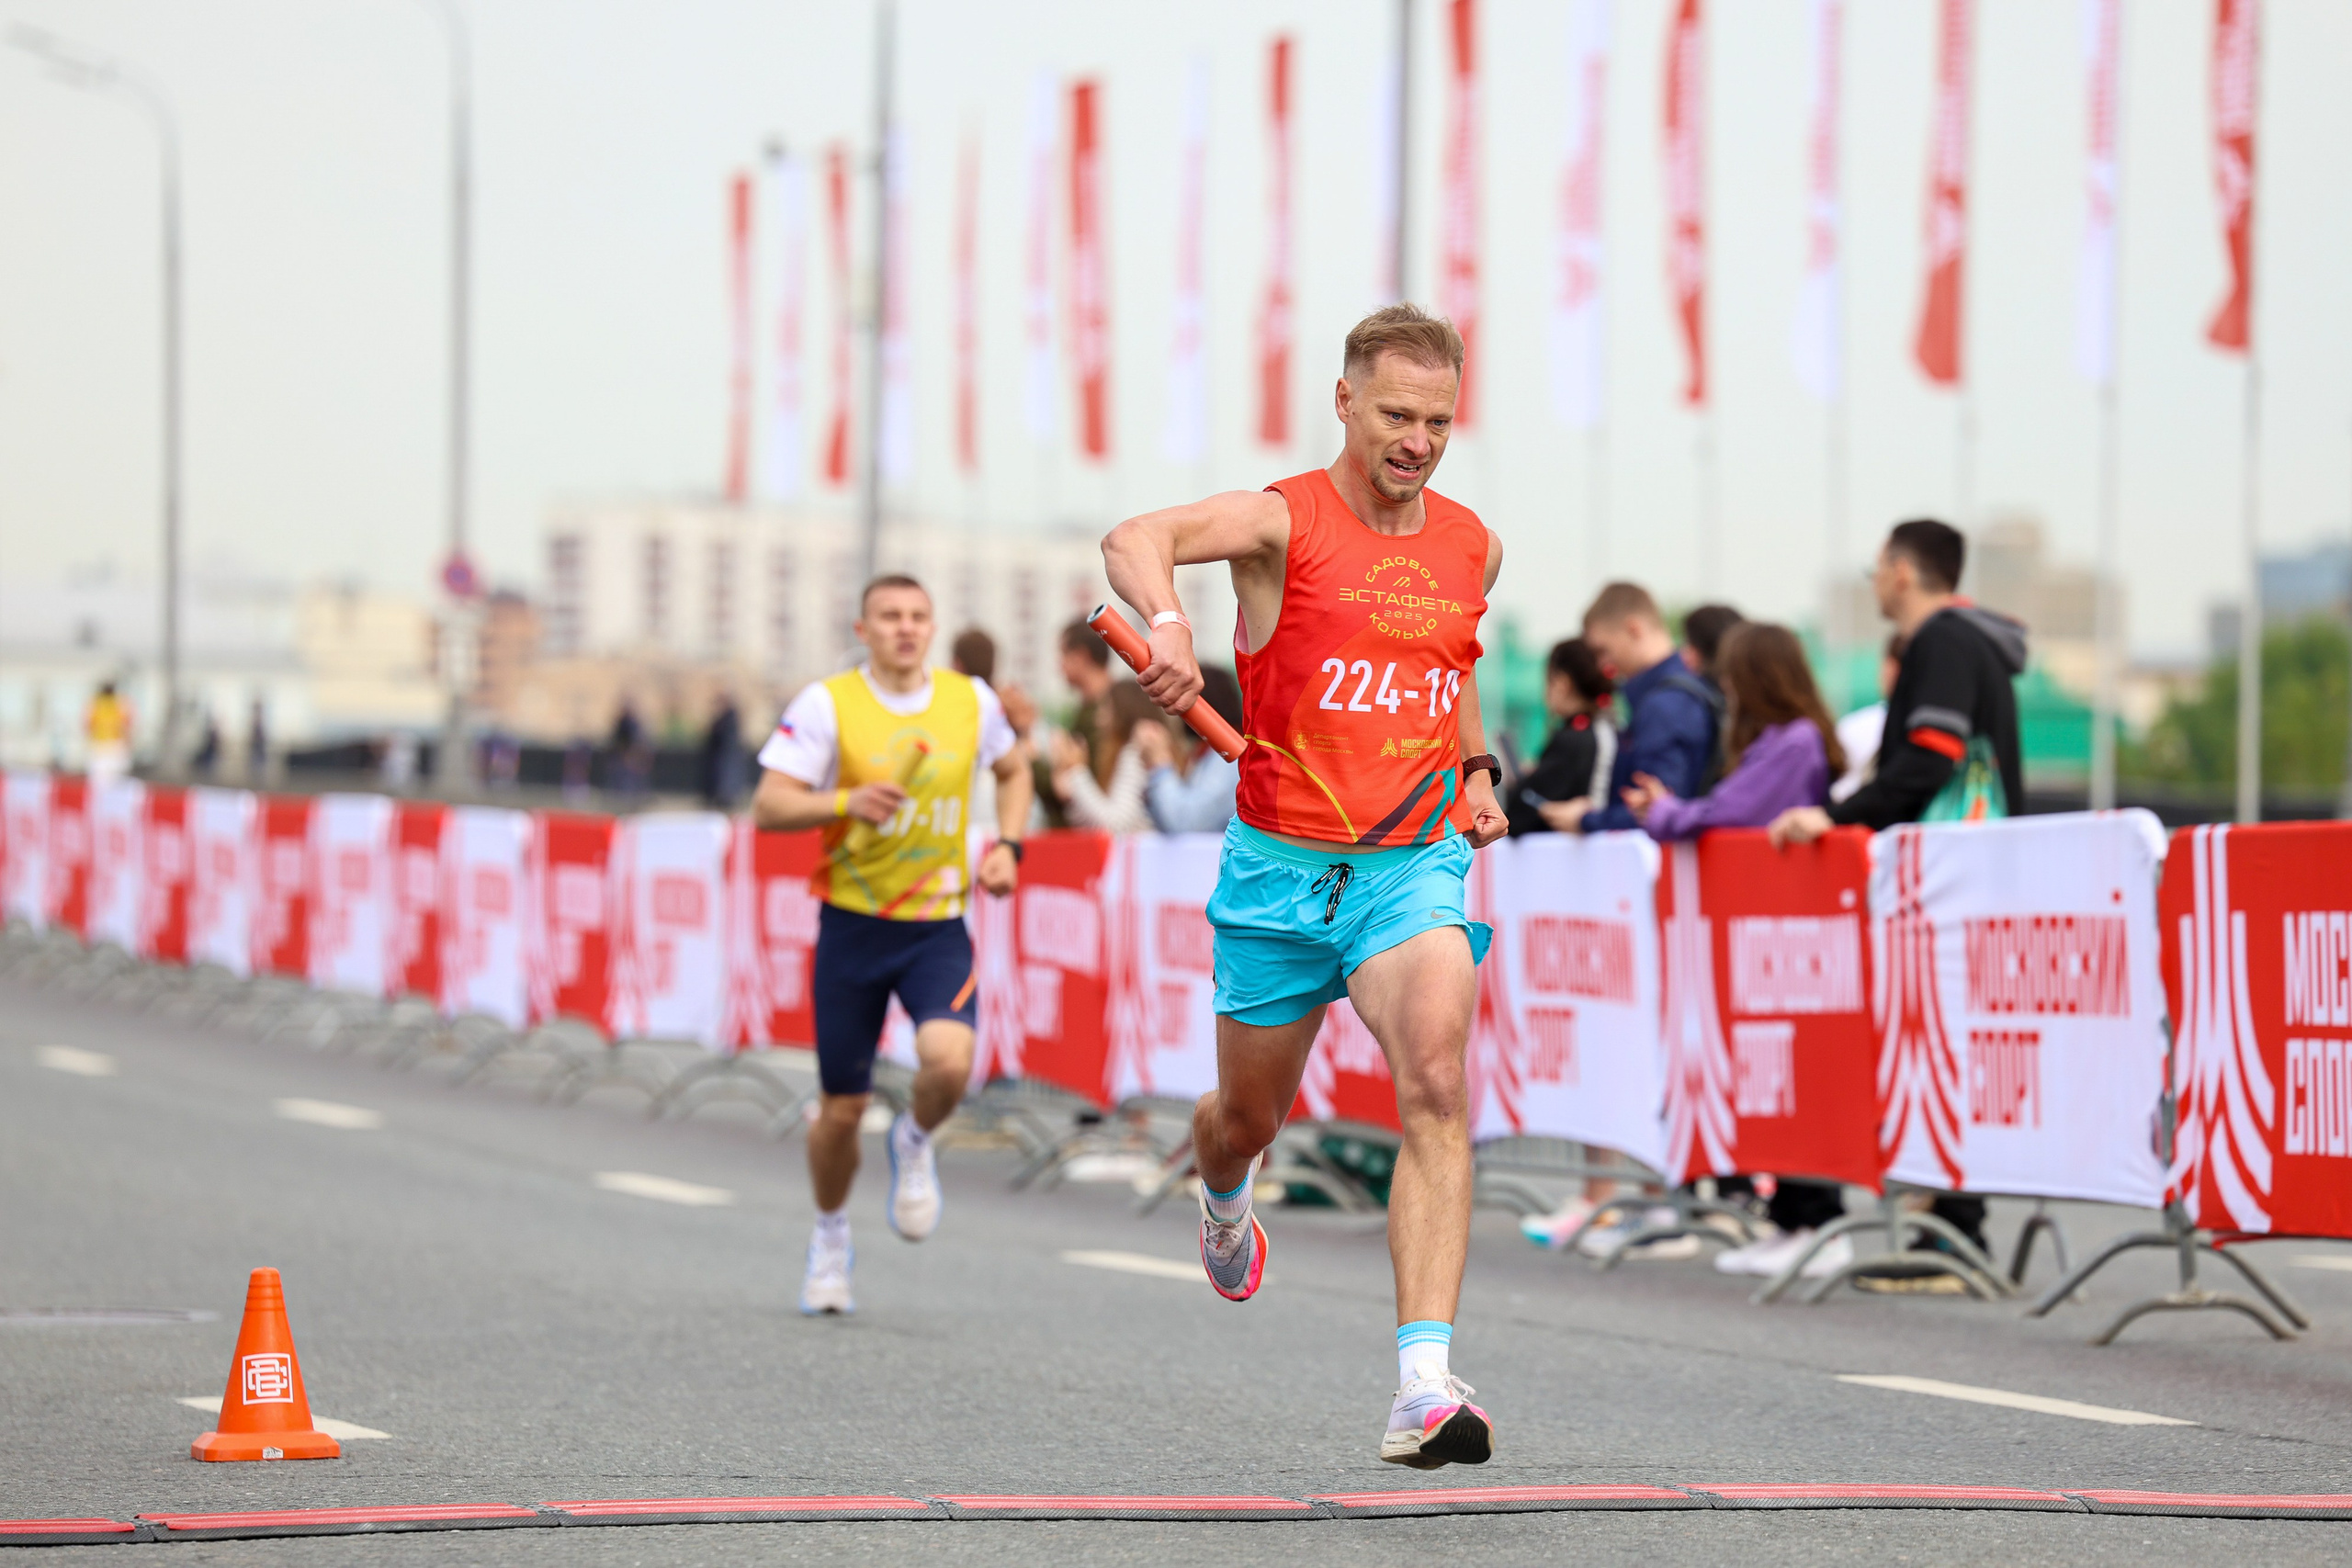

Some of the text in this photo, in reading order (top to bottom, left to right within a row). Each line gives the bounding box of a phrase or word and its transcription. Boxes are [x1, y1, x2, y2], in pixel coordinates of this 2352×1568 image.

[1365, 556, 1439, 591] САДОВОЕ
[1339, 588, 1463, 615] ЭСТАФЕТА
[1384, 609, 1423, 621] 2025
[1369, 612, 1437, 639] КОЛЬЦО
[1400, 749, 1422, 759] СПОРТ
[1401, 736, 1442, 750] МОСКОВСКИЙ
[2284, 911, 2352, 1027] МОС
[2285, 1038, 2352, 1157] СПО
